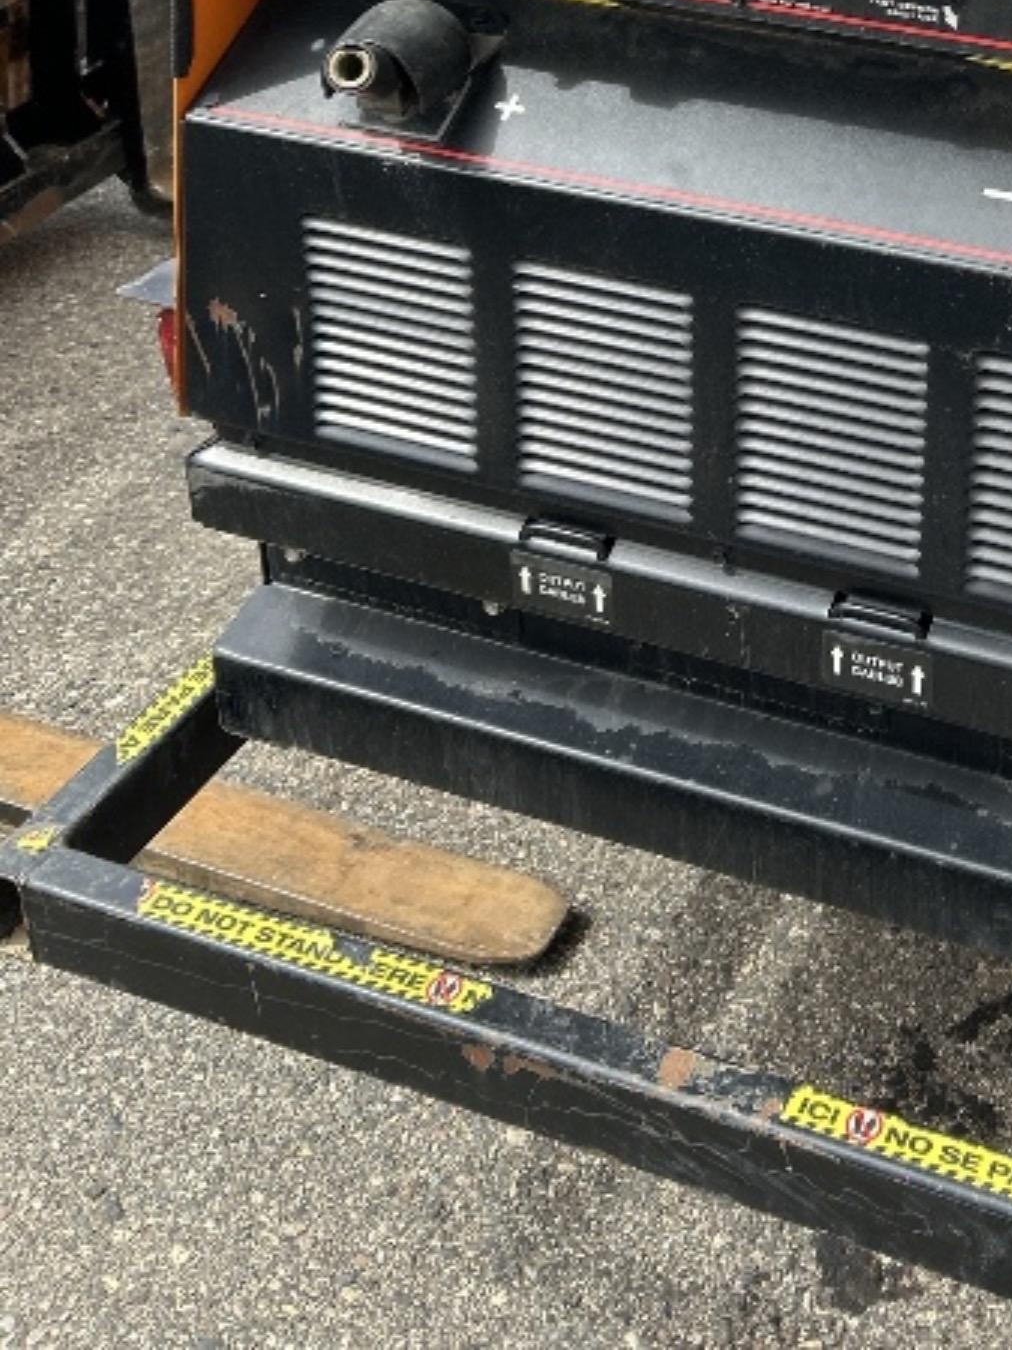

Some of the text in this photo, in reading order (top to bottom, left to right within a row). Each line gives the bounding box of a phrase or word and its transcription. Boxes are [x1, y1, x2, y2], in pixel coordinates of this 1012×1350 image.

[152, 895, 193, 918] DO
[195, 908, 256, 936] NOT
[354, 956, 428, 991] ERE
[797, 1097, 841, 1125] ICI
[884, 1128, 933, 1158] NO
[938, 1144, 984, 1172] SE
